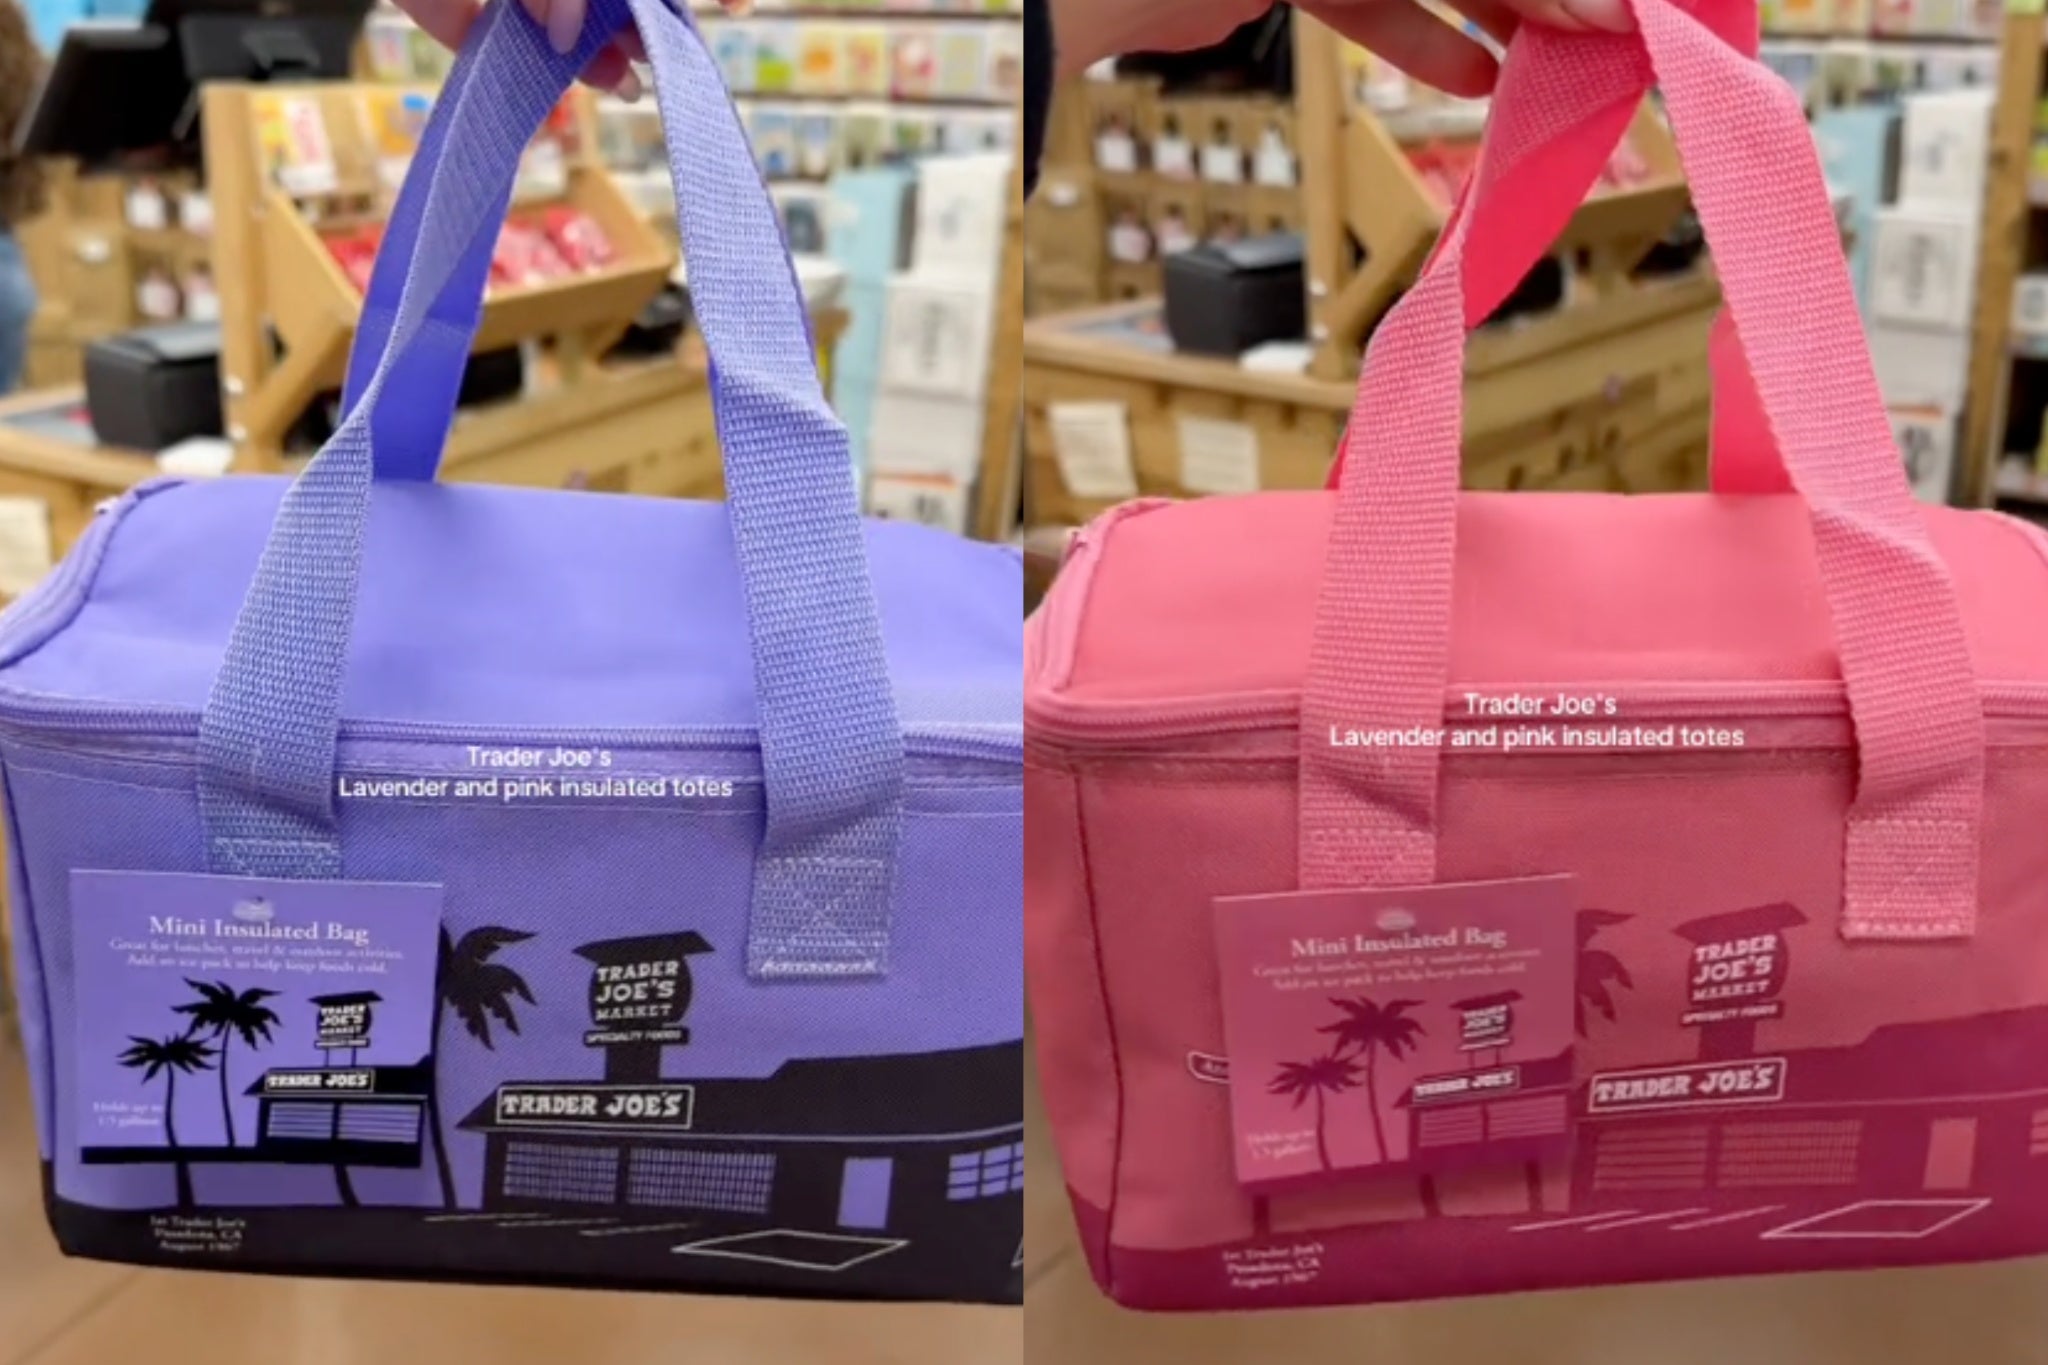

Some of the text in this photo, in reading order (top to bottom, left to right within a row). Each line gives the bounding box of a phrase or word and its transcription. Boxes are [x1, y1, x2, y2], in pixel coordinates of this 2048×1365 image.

[149, 916, 369, 945] Mini Insulated Bag
[1291, 926, 1507, 958] Mini Insulated Bag
[1695, 934, 1776, 962] TRADER
[597, 960, 679, 982] TRADER
[1693, 955, 1774, 985] JOE'S
[596, 978, 675, 1004] JOE'S
[1693, 978, 1770, 1001] MARKET
[595, 1003, 673, 1020] MARKET
[268, 1073, 369, 1088] TRADER JOE'S
[1596, 1064, 1775, 1103] TRADER JOE'S
[502, 1091, 683, 1117] TRADER JOE'S
